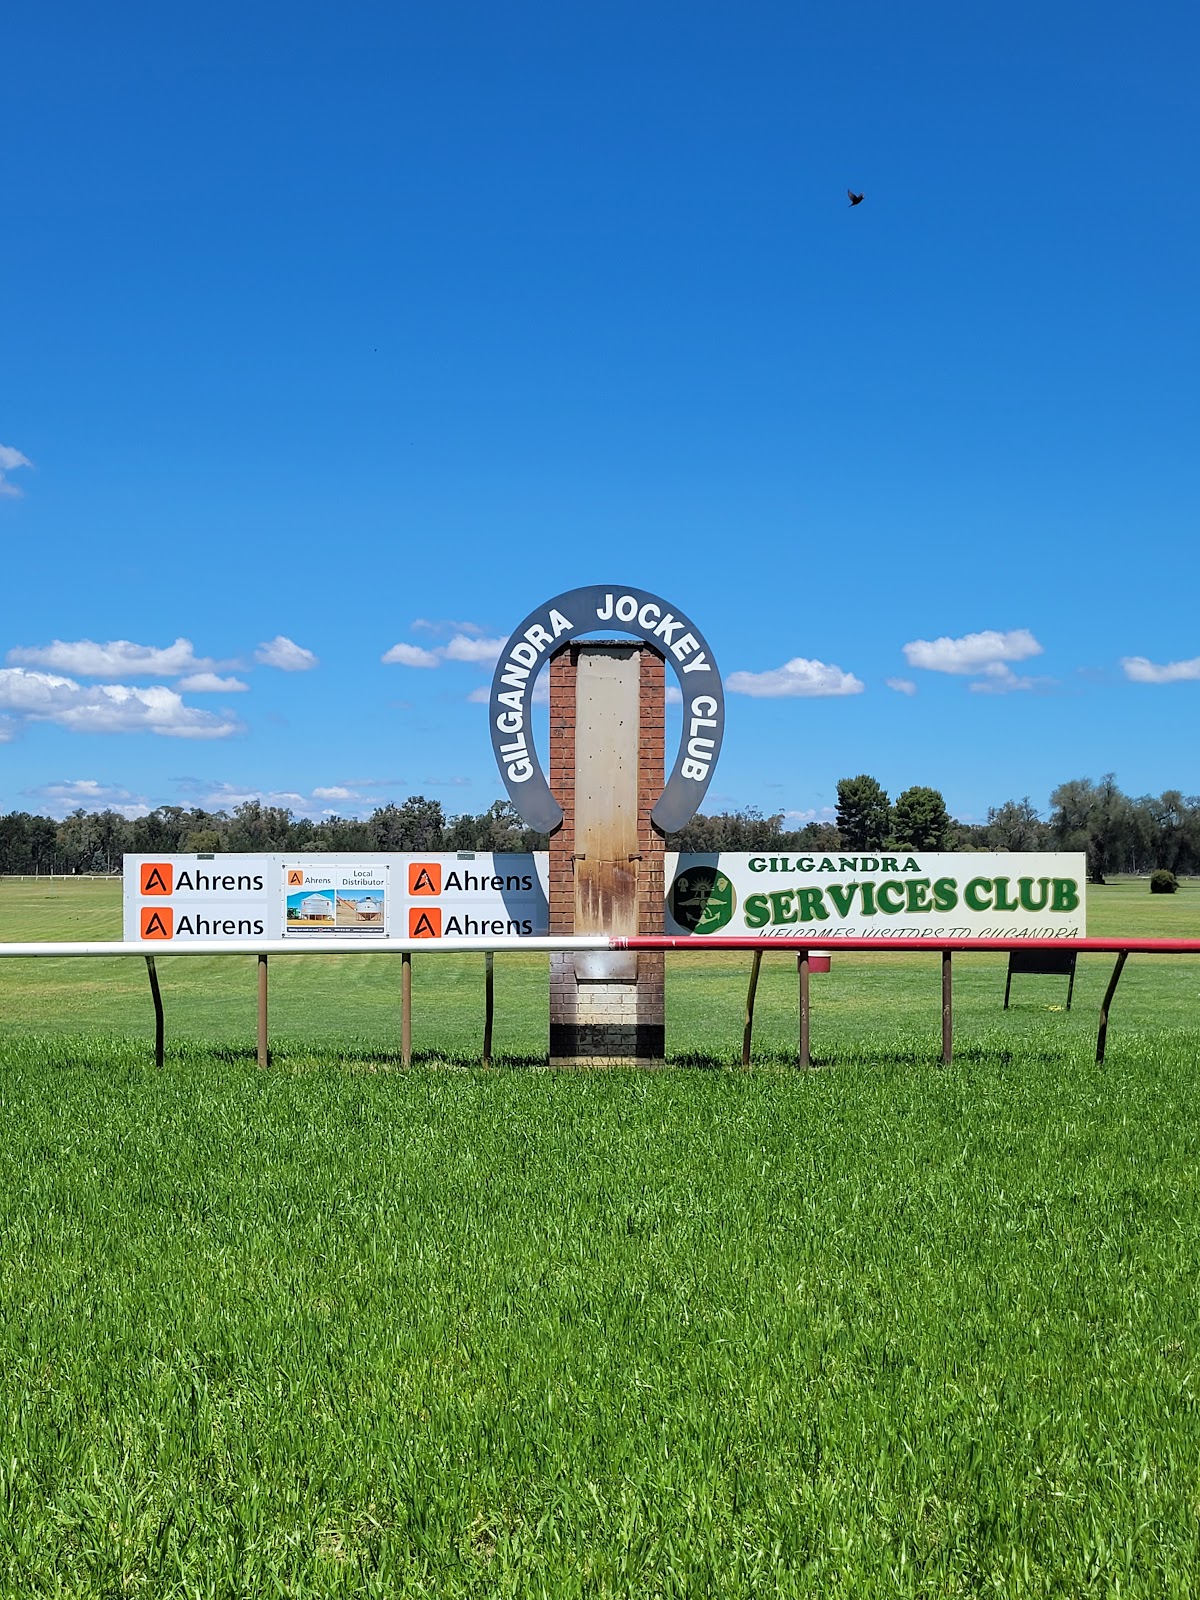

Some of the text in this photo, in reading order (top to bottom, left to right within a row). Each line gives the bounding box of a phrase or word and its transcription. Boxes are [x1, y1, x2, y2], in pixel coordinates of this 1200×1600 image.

[496, 594, 718, 783] GILGANDRA JOCKEY CLUB
[748, 857, 922, 873] GILGANDRA
[175, 870, 264, 891] Ahrens
[342, 878, 385, 886] Distributor
[443, 871, 533, 891] Ahrens
[743, 876, 1080, 929] SERVICES CLUB
[175, 915, 265, 935] Ahrens
[444, 915, 533, 935] Ahrens
